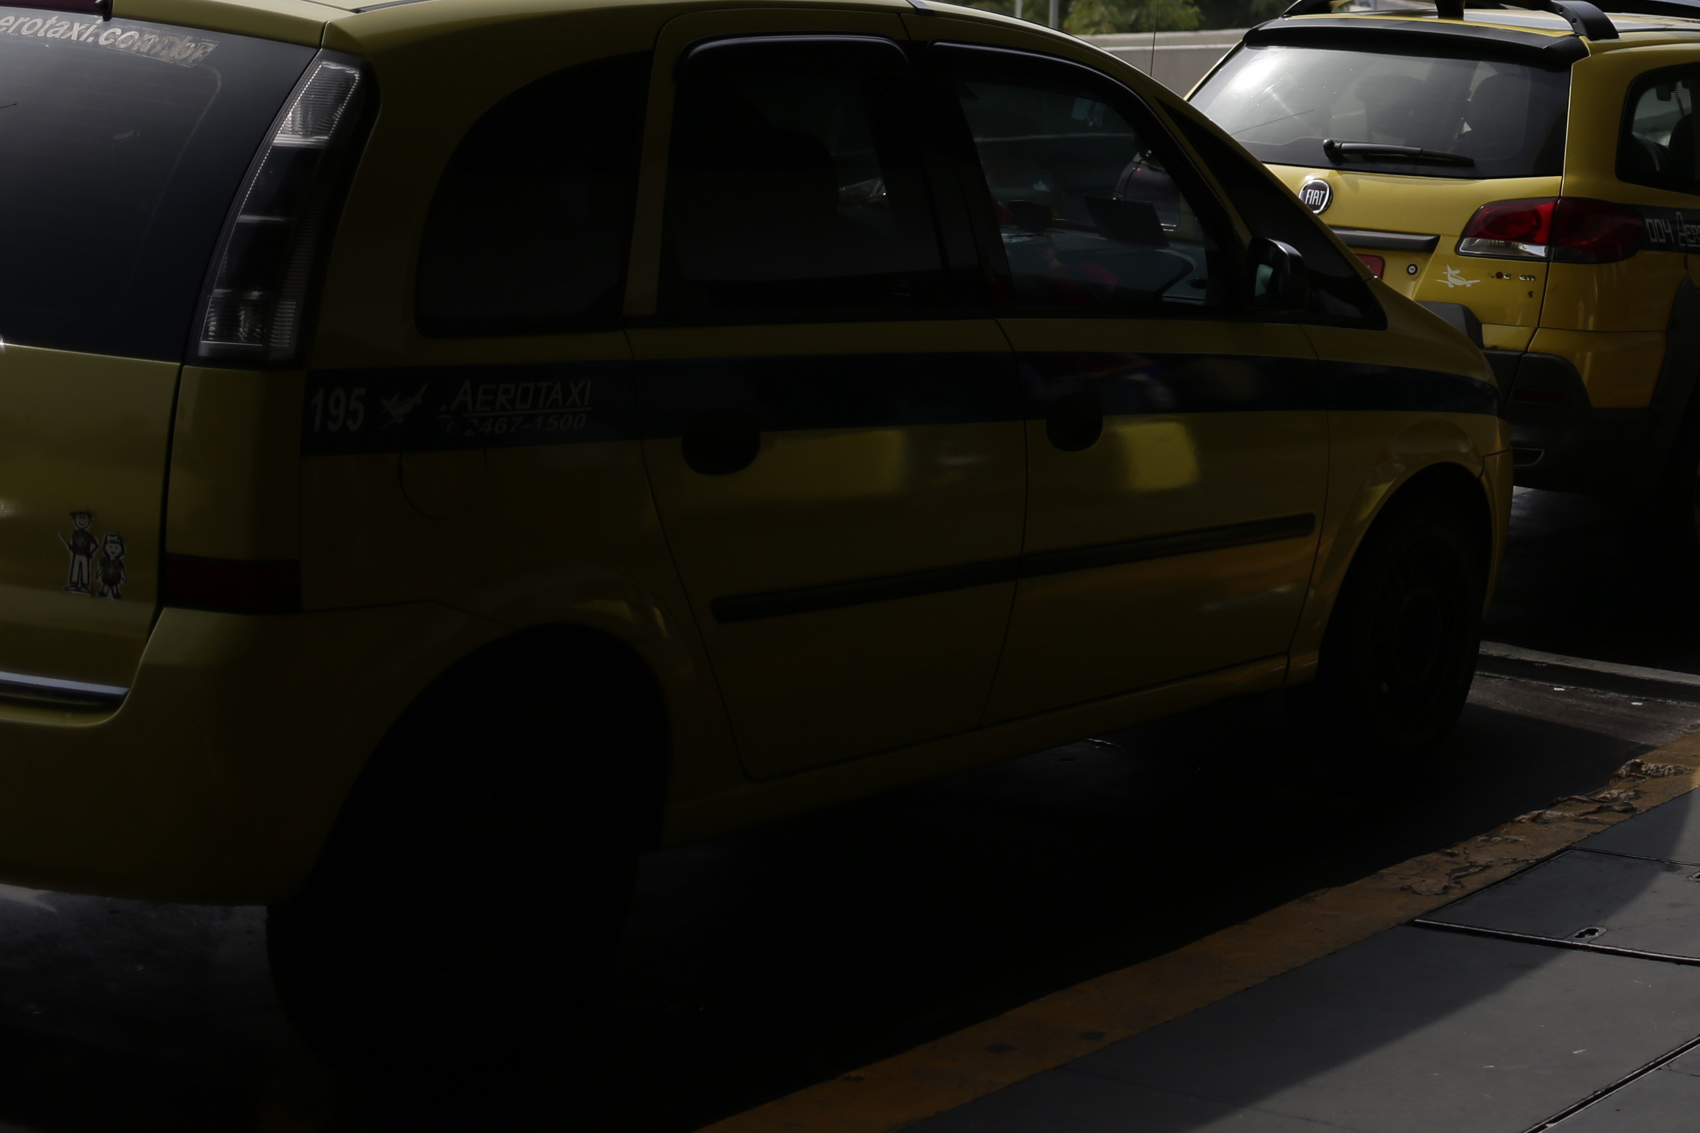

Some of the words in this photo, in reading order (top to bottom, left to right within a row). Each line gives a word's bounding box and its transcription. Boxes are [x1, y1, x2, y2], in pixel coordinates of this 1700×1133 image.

[1305, 189, 1325, 205] FIAT
[1644, 218, 1675, 243] 004
[310, 387, 367, 433] 195
[451, 379, 593, 411] AEROTAXI
[461, 413, 587, 437] 2467-1500
